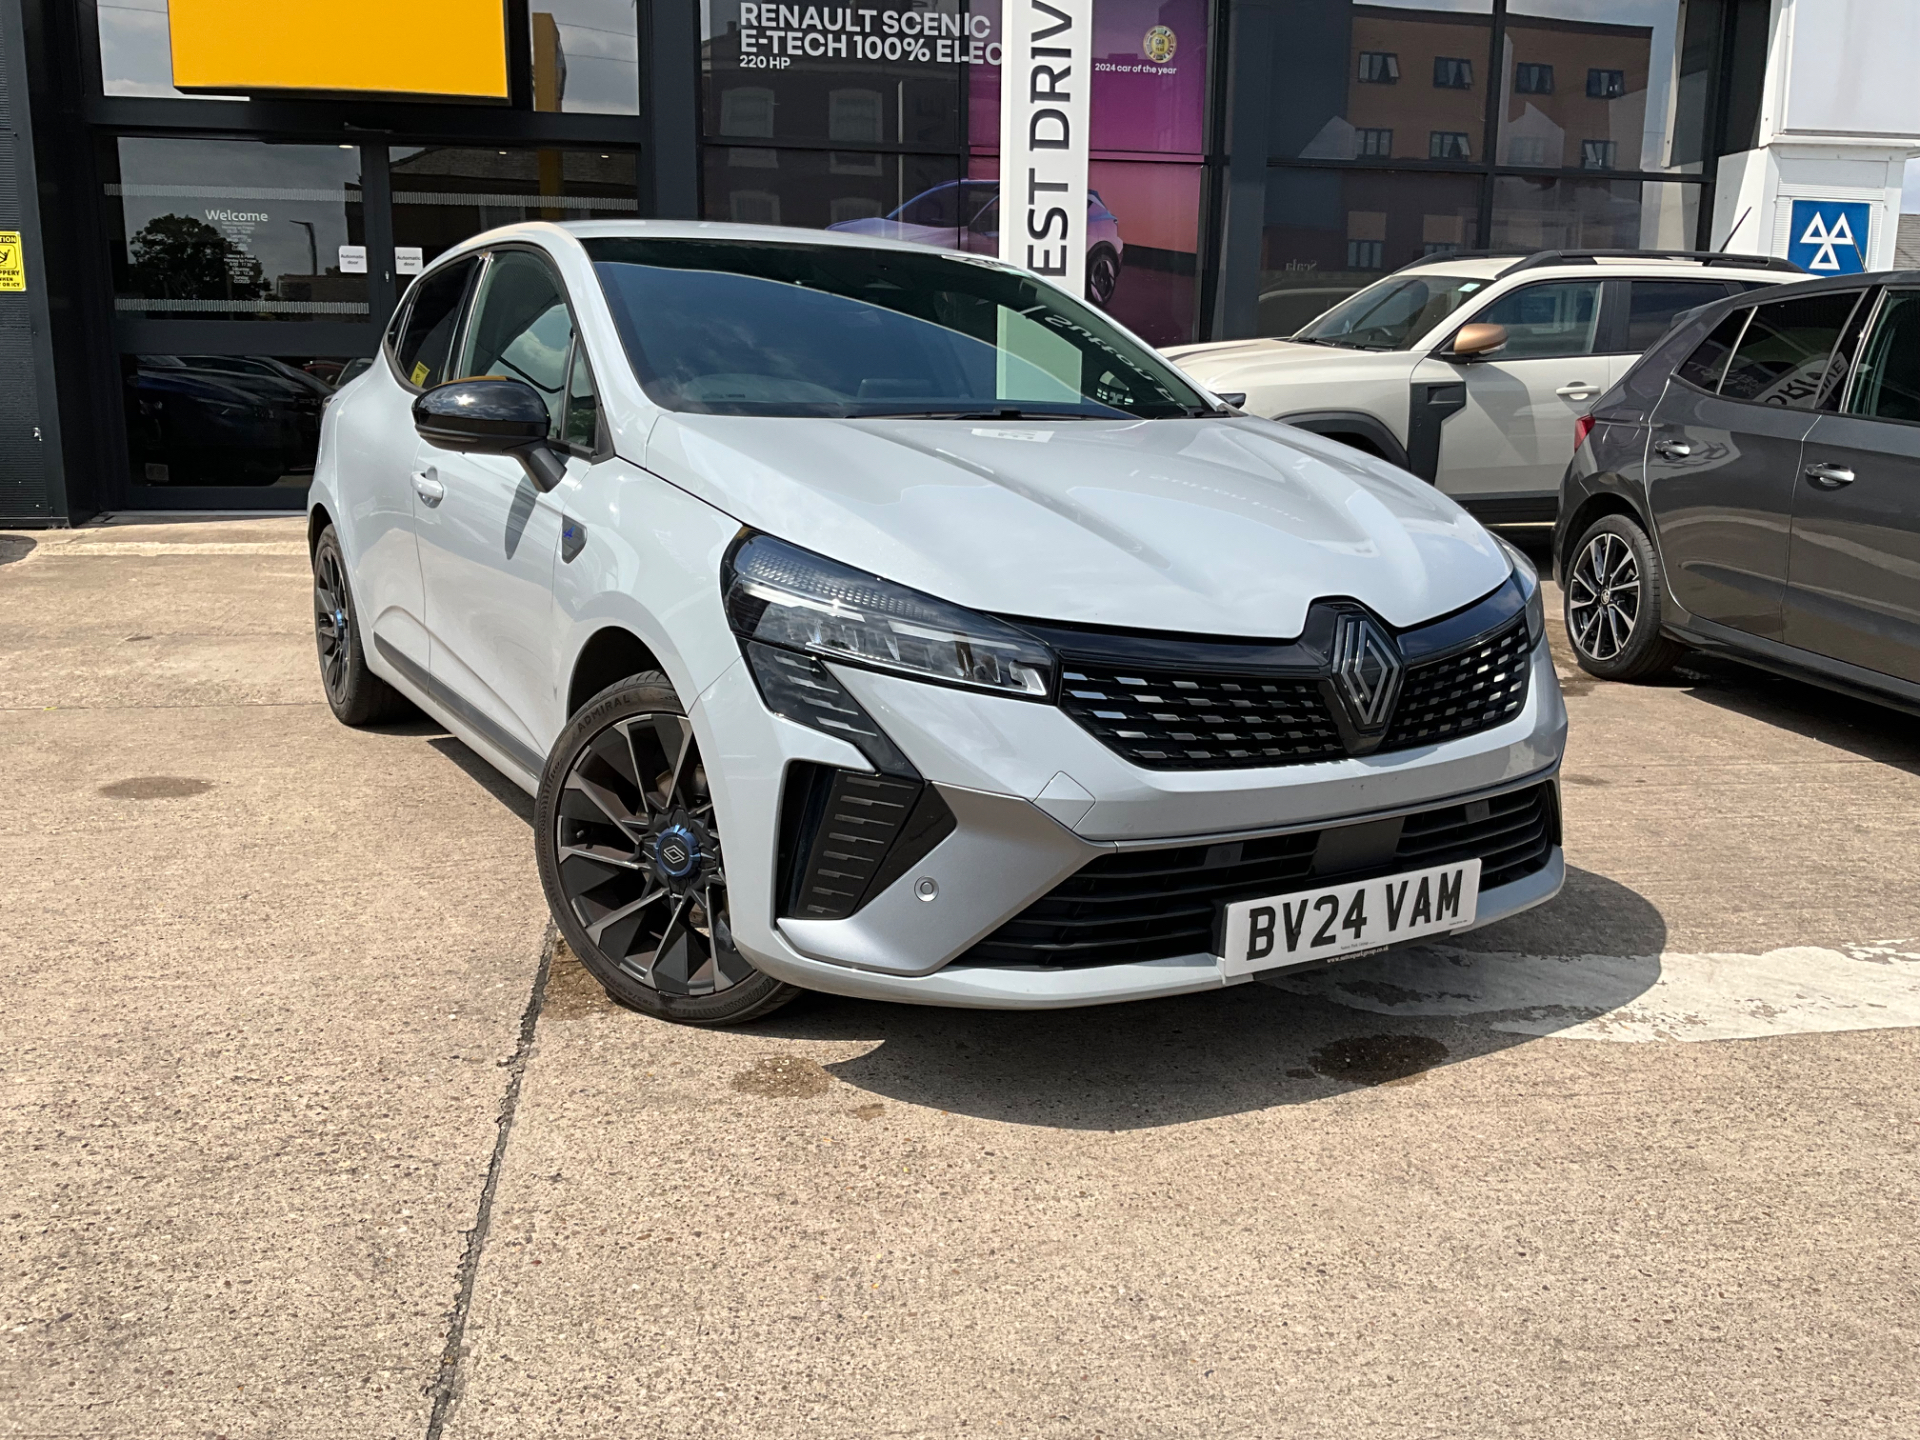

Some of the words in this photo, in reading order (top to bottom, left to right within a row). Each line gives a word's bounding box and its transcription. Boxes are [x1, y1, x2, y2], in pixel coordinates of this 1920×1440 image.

[741, 2, 877, 32] RENAULT
[882, 10, 991, 38] SCENIC
[740, 55, 767, 68] 220
[769, 56, 791, 69] HP
[741, 29, 847, 58] E-TECH
[853, 34, 931, 62] 100%
[1094, 63, 1116, 72] 2024
[1132, 64, 1142, 72] of
[1143, 65, 1157, 73] the
[1158, 66, 1177, 75] year
[205, 209, 269, 221] Welcome
[577, 694, 631, 735] ADMIRAL
[1246, 888, 1367, 961] BV24
[1385, 869, 1463, 932] VAM
